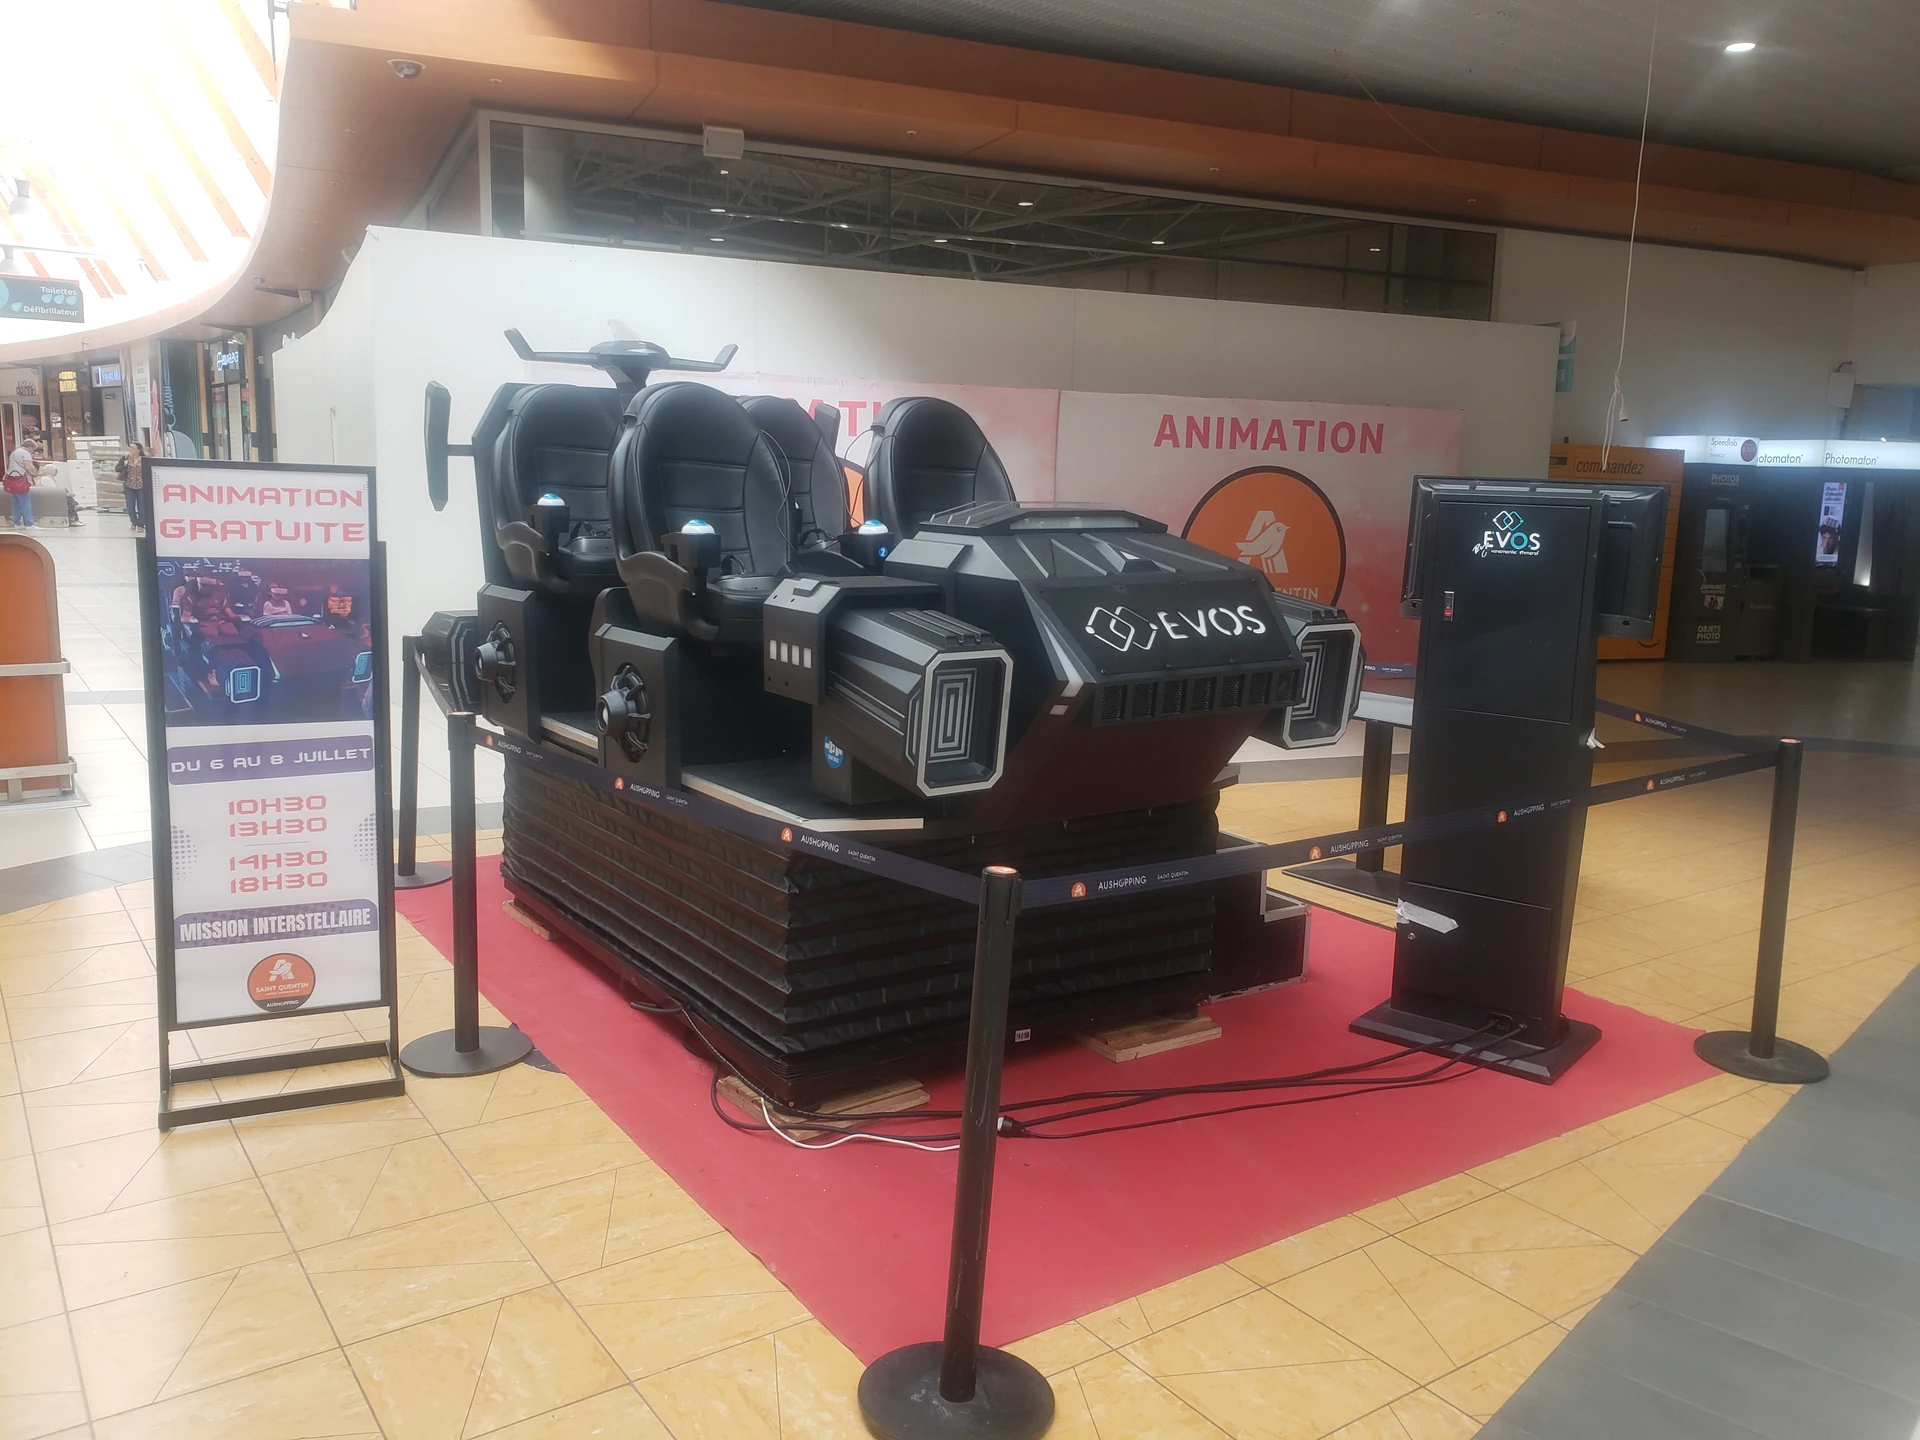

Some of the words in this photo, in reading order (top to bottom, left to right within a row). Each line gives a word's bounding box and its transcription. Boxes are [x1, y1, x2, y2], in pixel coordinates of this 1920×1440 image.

[40, 286, 77, 295] Toilettes
[23, 305, 78, 316] Défibrillateur
[1153, 413, 1384, 454] ANIMATION
[1710, 437, 1738, 447] Speedlab
[1757, 454, 1802, 464] otomaton
[1711, 473, 1740, 482] PHOTOS
[163, 483, 363, 508] ANIMATION
[160, 518, 366, 544] GRATUITE
[1483, 531, 1541, 551] EVOS
[1156, 605, 1267, 640] EVOS
[1696, 632, 1720, 640] PHOTO
[171, 759, 201, 773] DU
[210, 759, 224, 770] 6
[233, 755, 261, 769] AU
[270, 755, 284, 765] 8
[293, 748, 371, 764] JUILLET
[228, 795, 327, 816] 10H30
[230, 817, 328, 838] 13H30
[801, 835, 840, 853] AUSHOPPING
[1330, 840, 1369, 853] AUSHOPPING
[230, 850, 328, 871] 14H30
[230, 872, 328, 894] 18H30
[1097, 876, 1147, 890] AUSHOPPING
[180, 919, 248, 942] MISSION
[253, 908, 371, 935] INTERSTELLAIRE
[256, 985, 276, 993] SAINT
[278, 982, 309, 991] QUENTIN
[266, 1000, 299, 1008] AUSHOPPING
